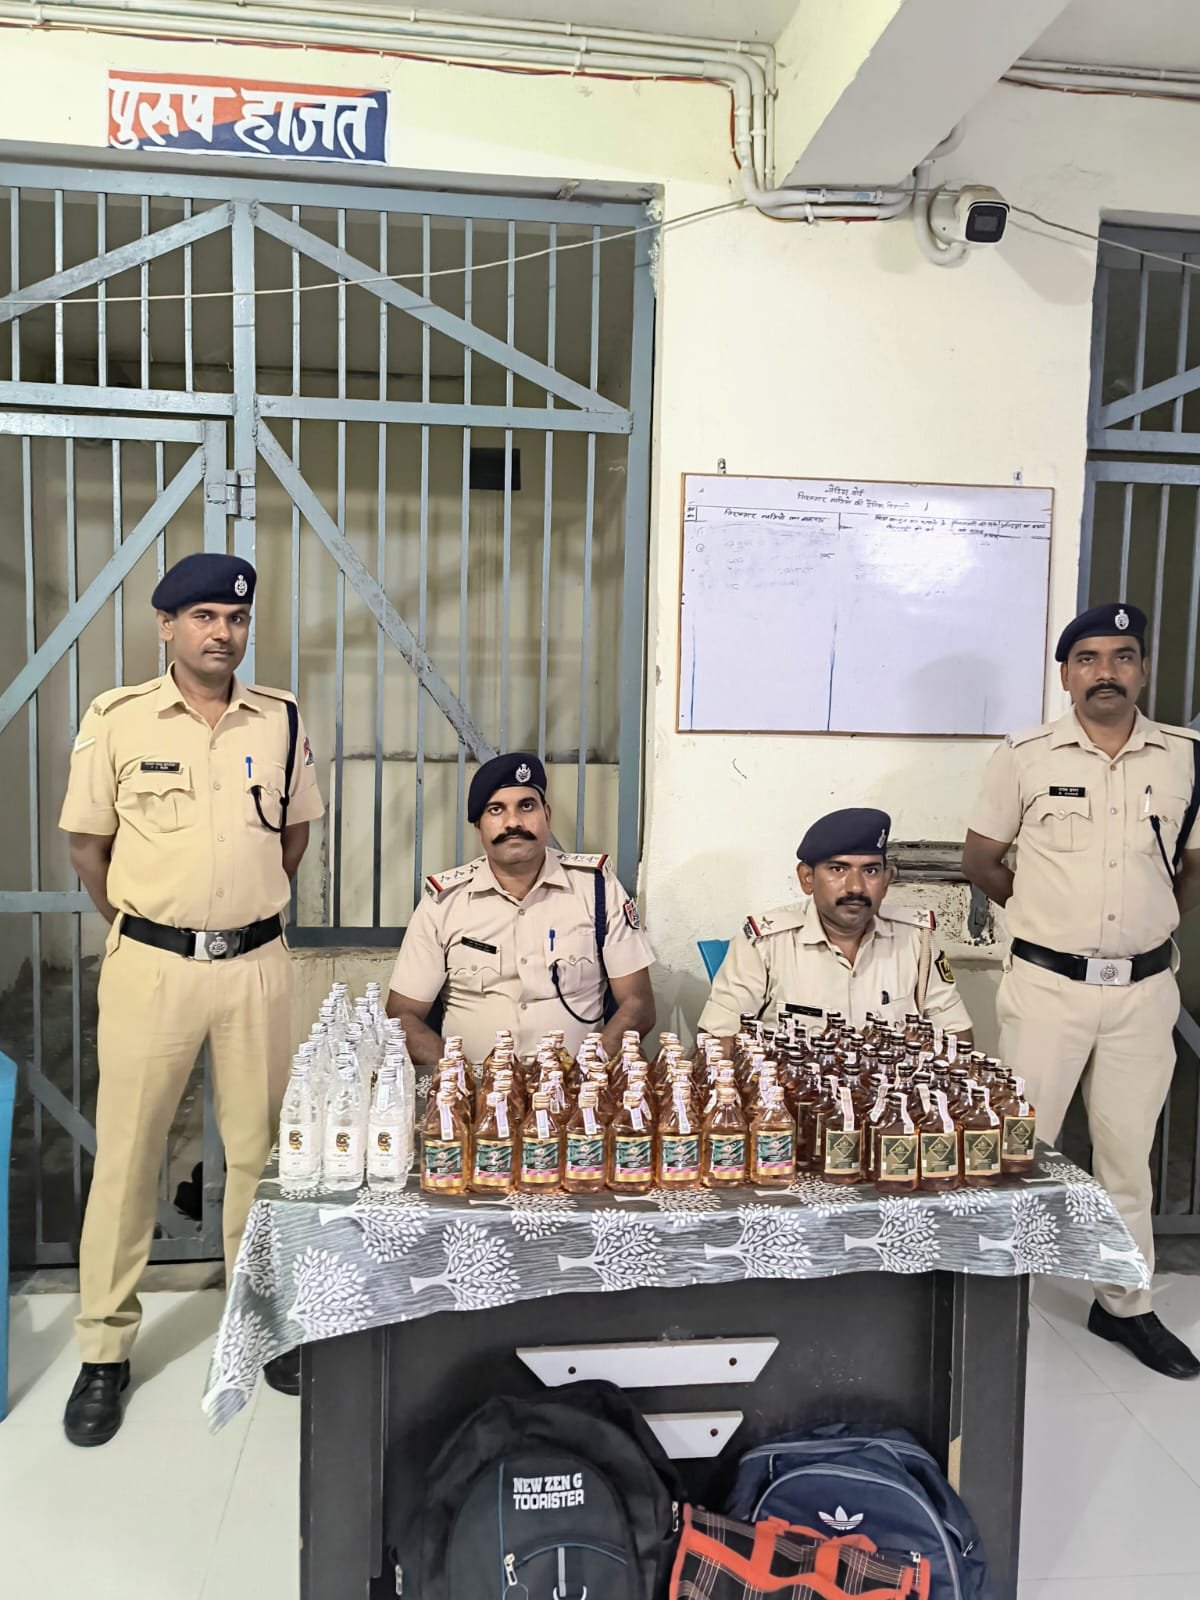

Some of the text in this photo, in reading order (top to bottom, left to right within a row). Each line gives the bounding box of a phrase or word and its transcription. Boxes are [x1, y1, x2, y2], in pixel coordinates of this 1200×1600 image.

[233, 87, 378, 159] हाजत
[513, 1477, 543, 1493] NEW
[544, 1474, 571, 1492] ZEN
